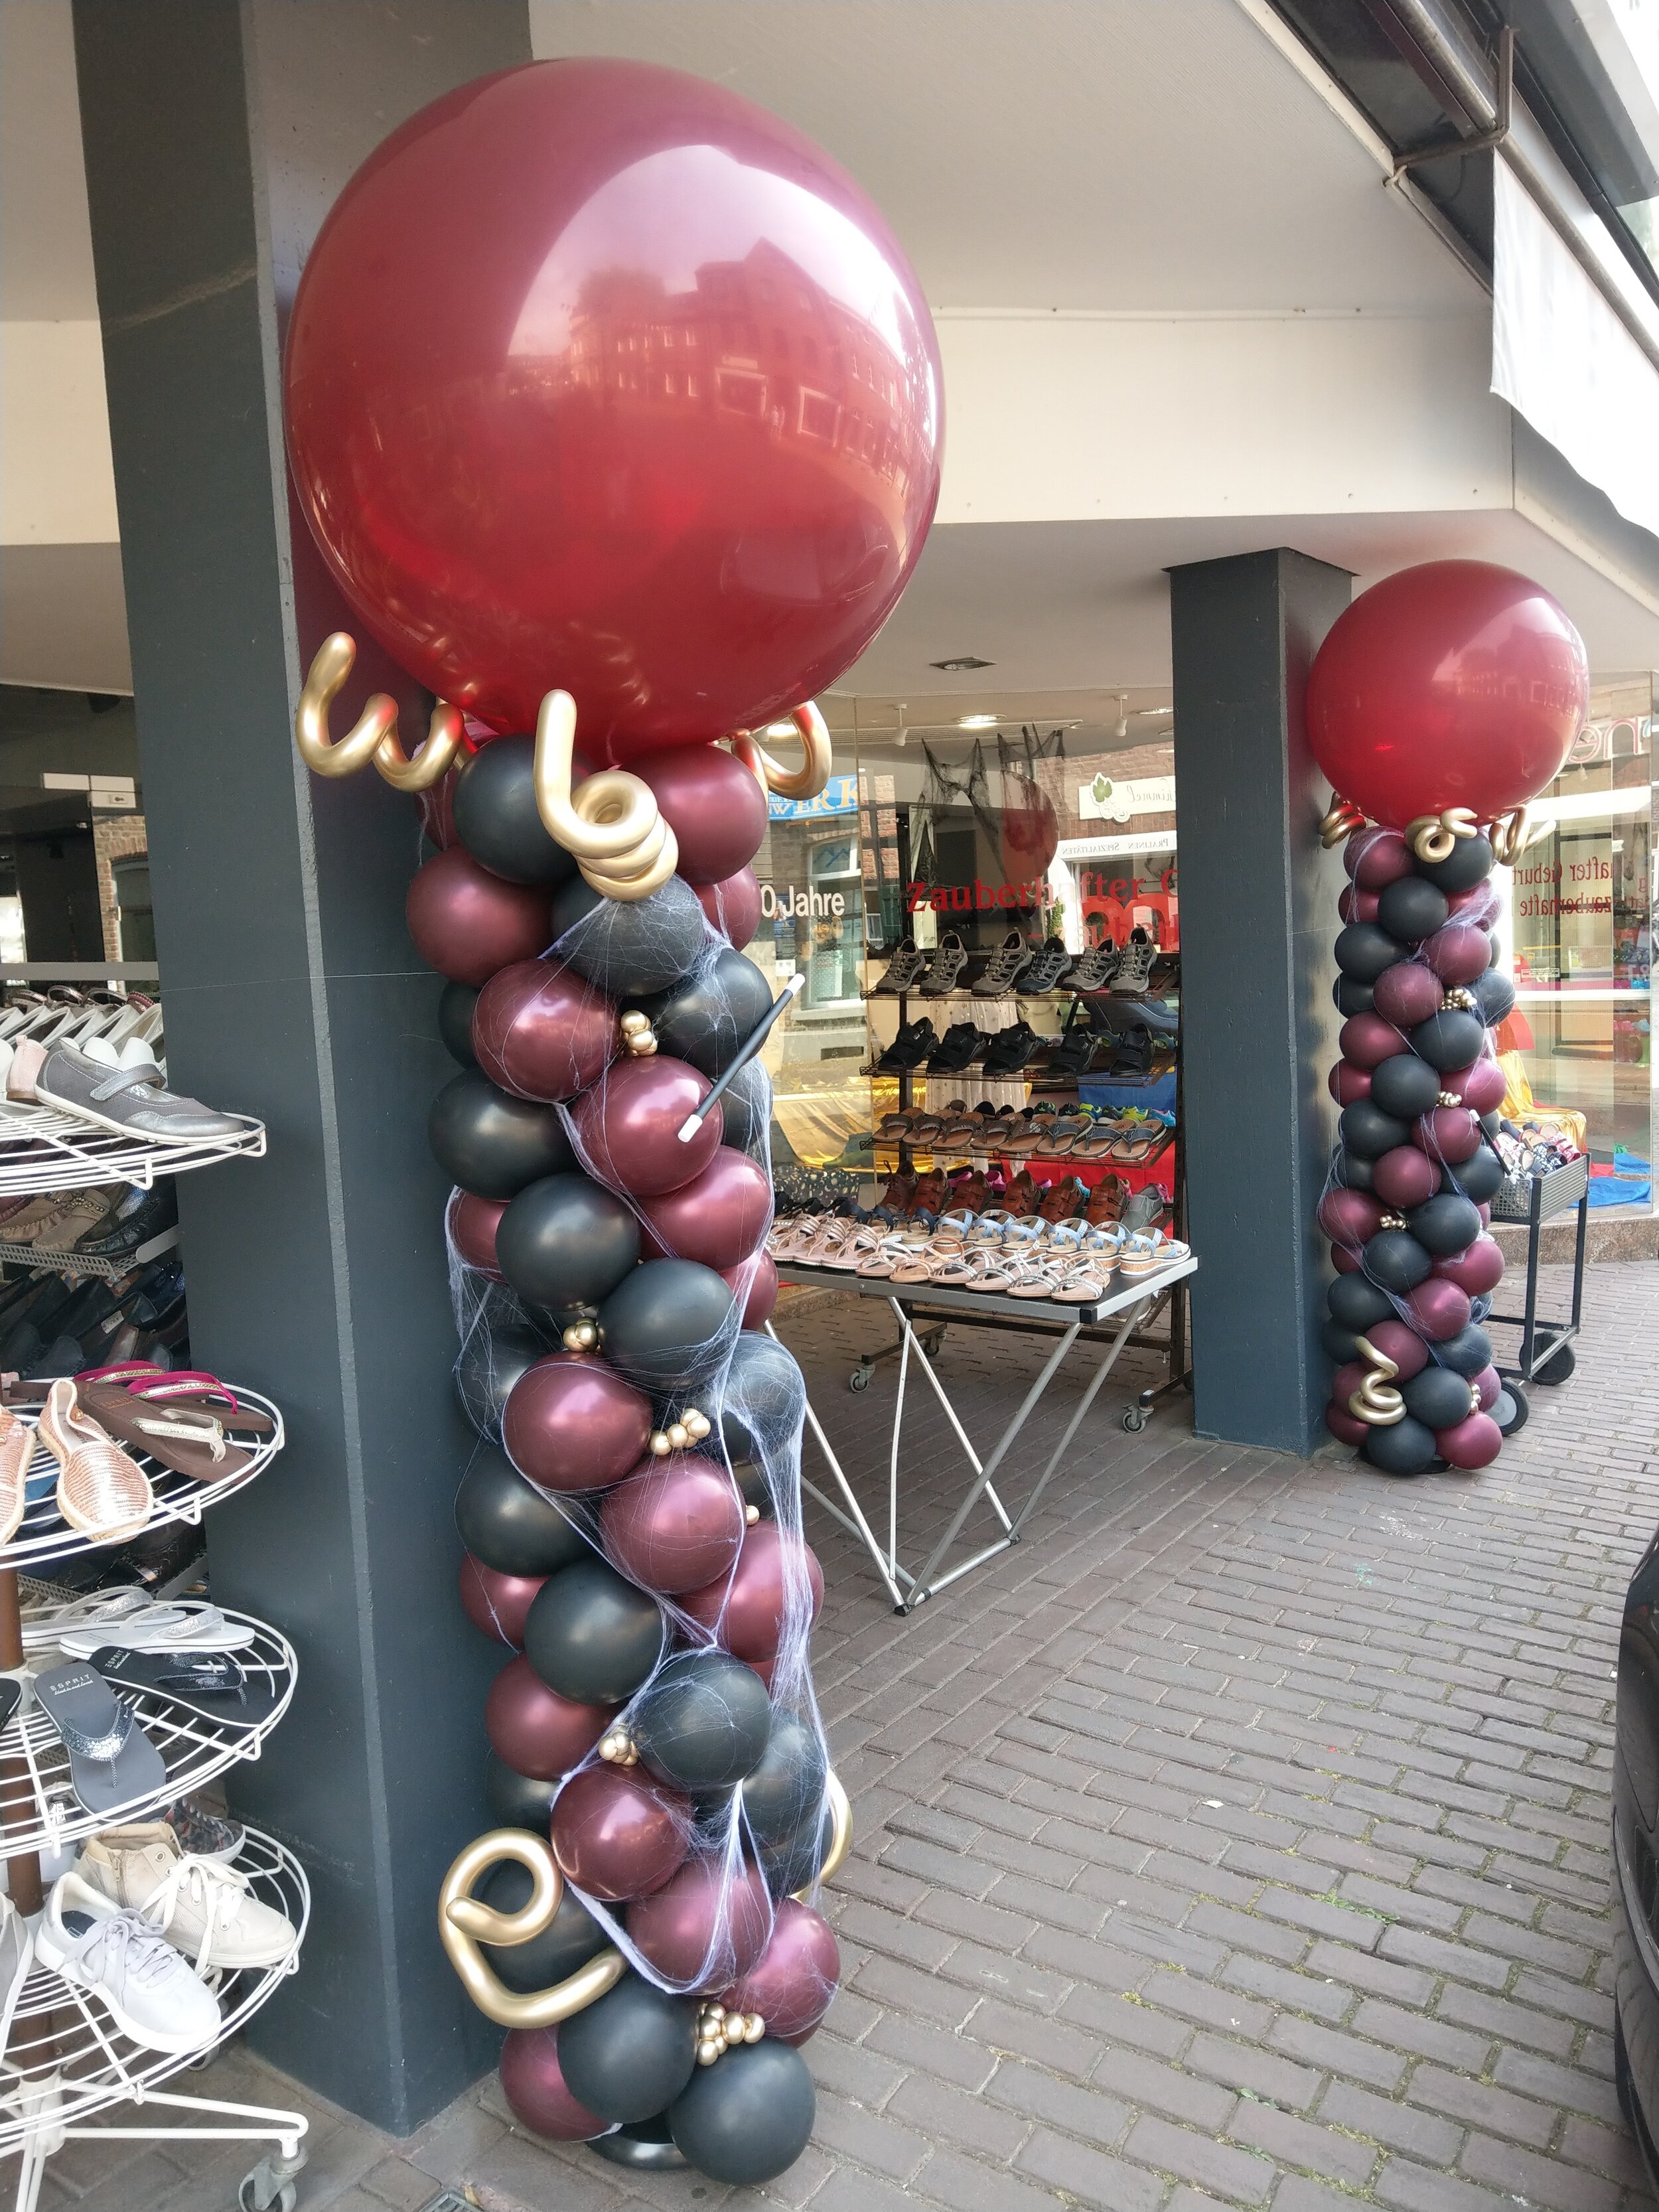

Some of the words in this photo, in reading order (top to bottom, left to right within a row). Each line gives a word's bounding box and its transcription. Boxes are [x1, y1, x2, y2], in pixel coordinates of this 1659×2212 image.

[782, 885, 845, 917] Jahre
[104, 1649, 125, 1668] ESPRIT
[49, 1674, 90, 1692] ESPRIT
